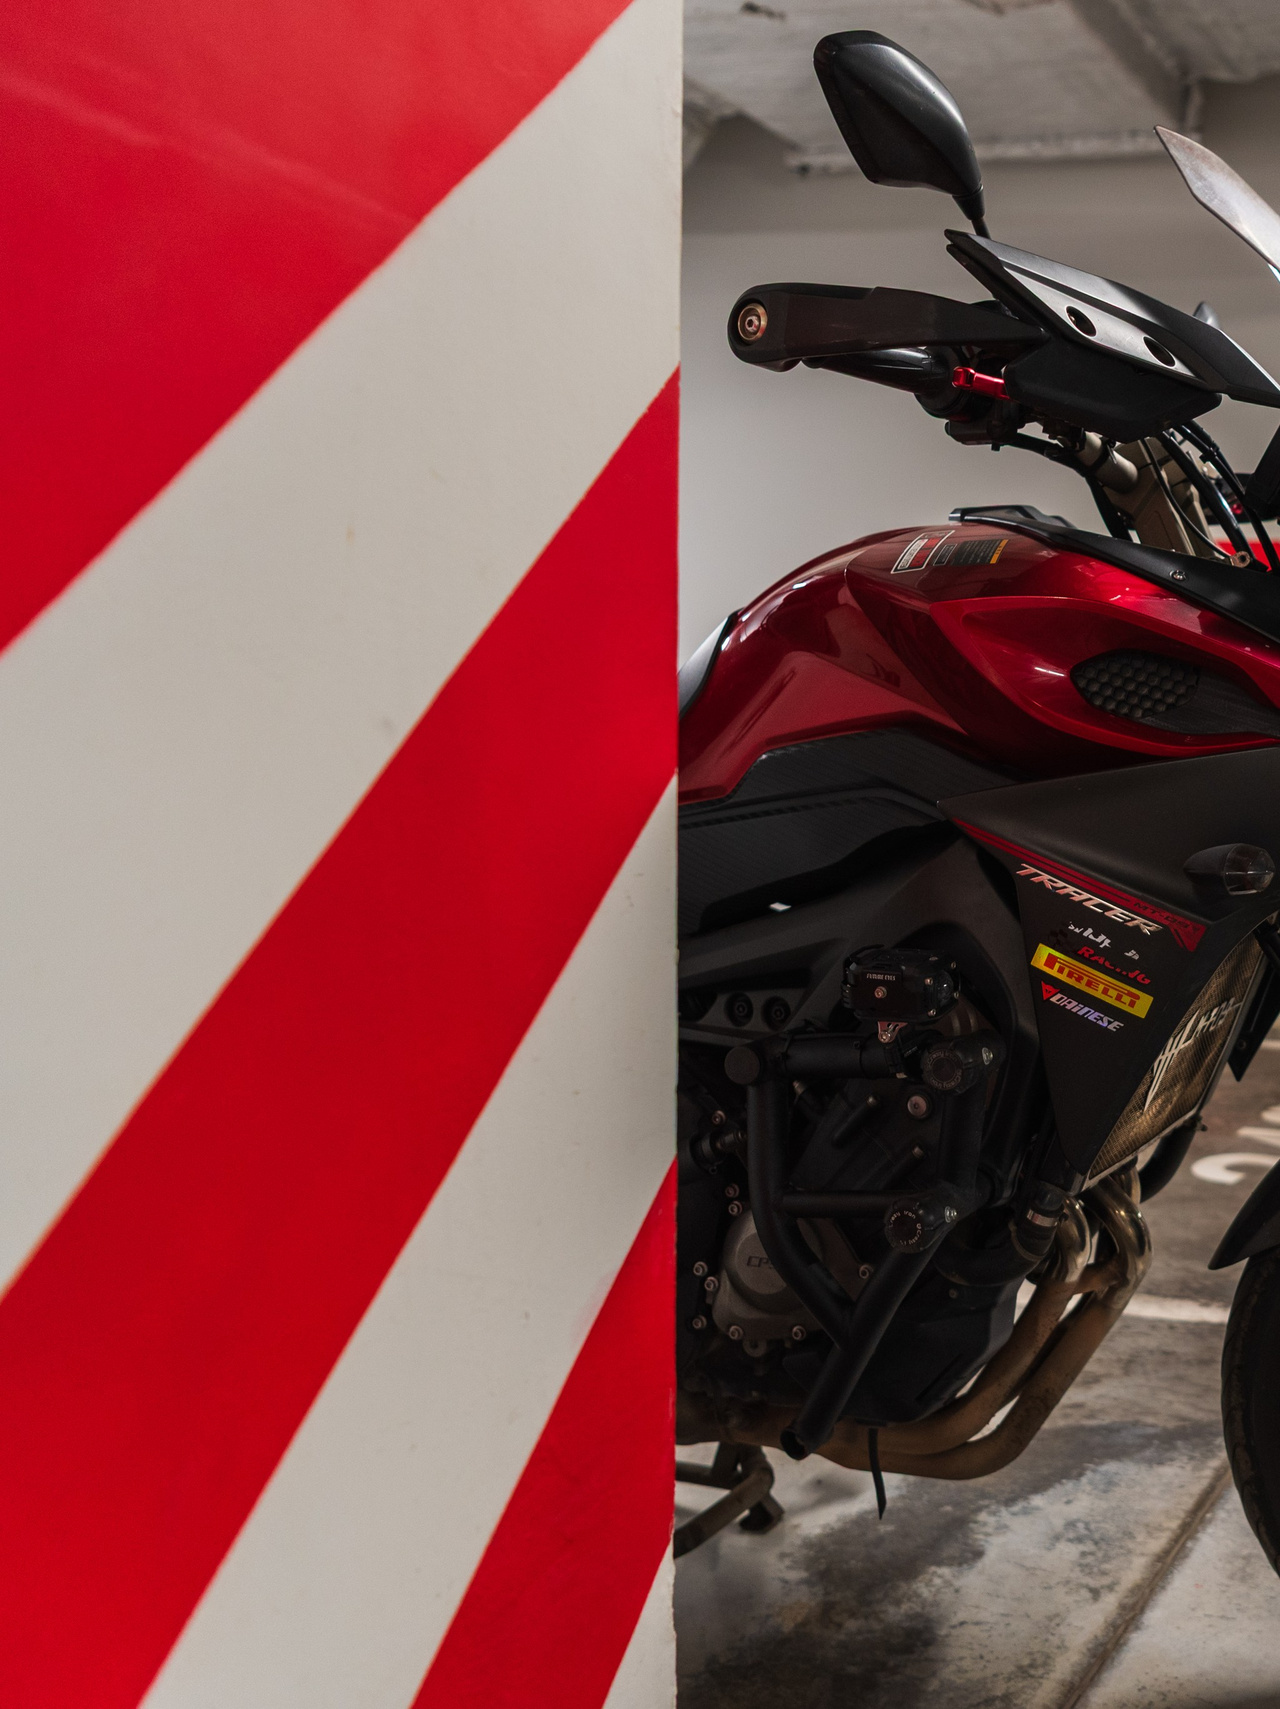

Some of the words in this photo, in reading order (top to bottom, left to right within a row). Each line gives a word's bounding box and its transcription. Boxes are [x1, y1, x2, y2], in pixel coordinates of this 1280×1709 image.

[1016, 863, 1163, 935] TRACER
[1043, 952, 1141, 1009] PIRELLI
[746, 1255, 772, 1270] CP
